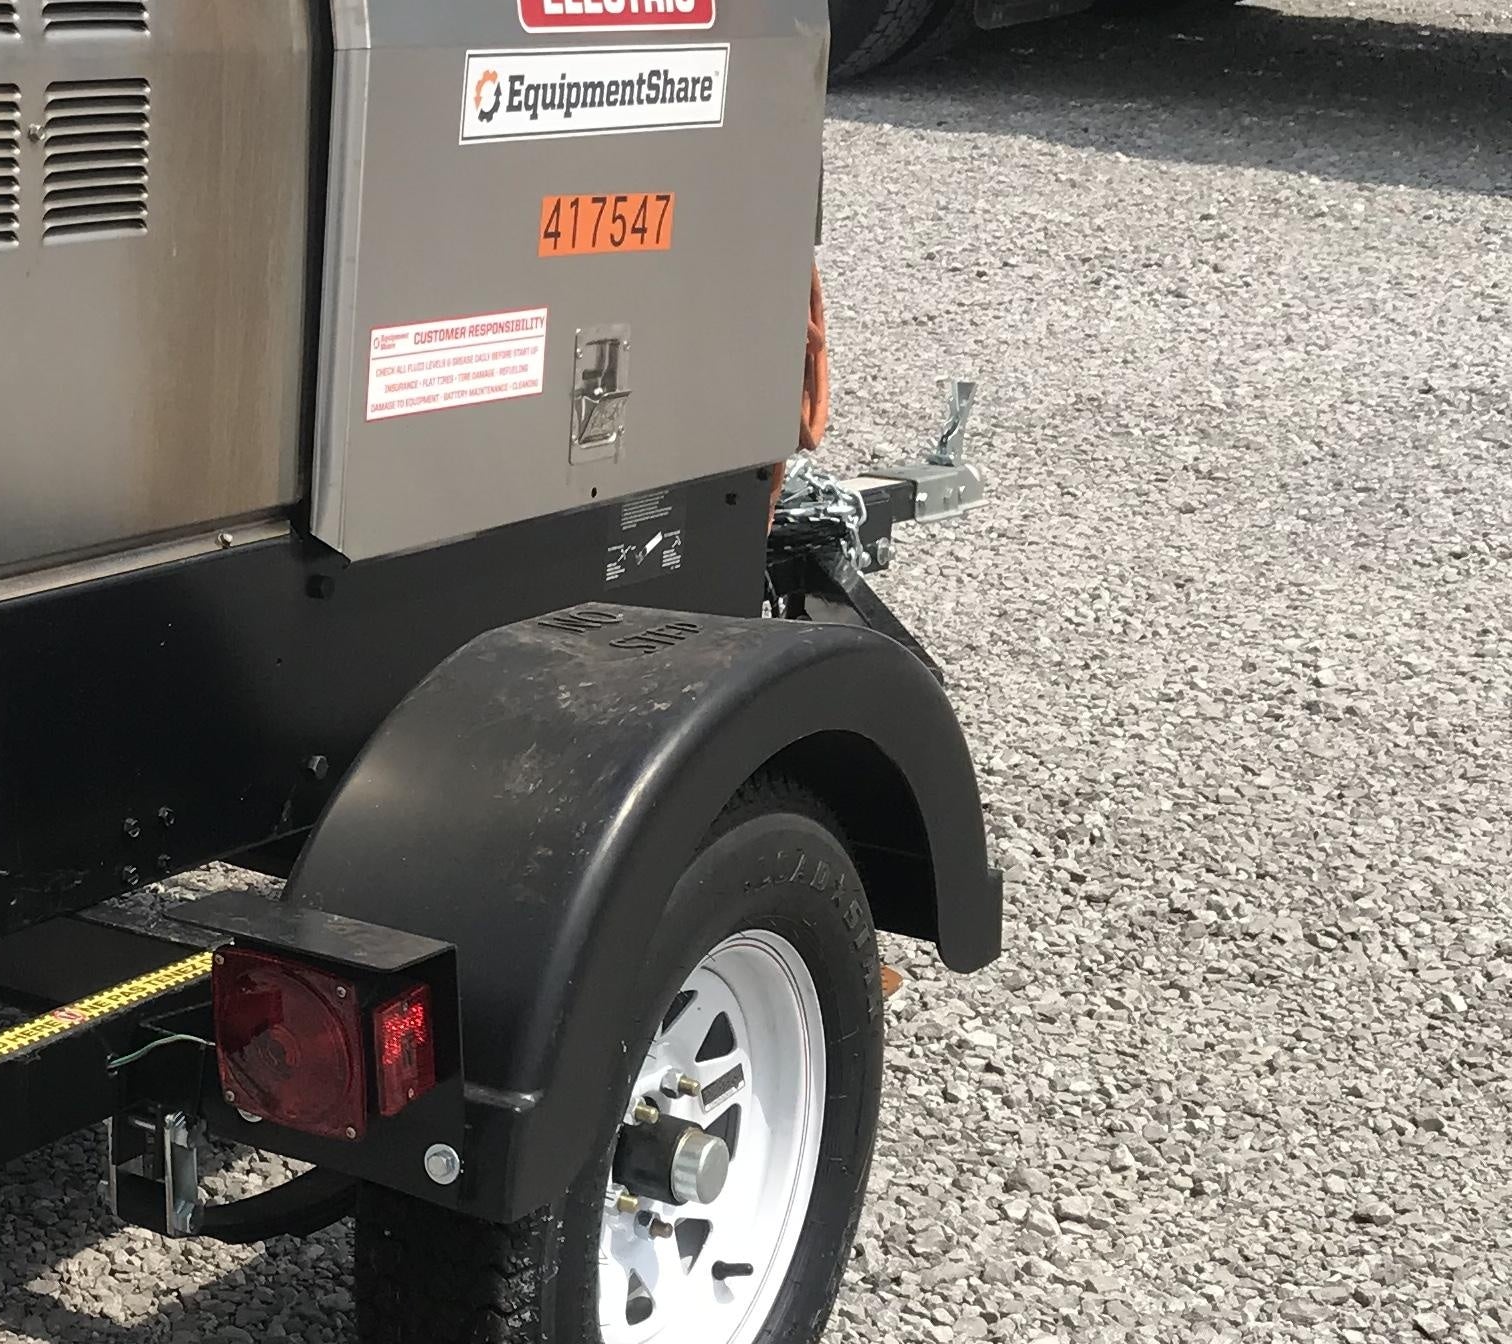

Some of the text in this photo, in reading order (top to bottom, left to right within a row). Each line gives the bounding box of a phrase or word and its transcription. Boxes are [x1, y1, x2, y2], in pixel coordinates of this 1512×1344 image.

[505, 69, 714, 120] EquipmentShare
[542, 194, 672, 251] 417547
[413, 315, 545, 345] CUSTOMER RESPONSIBILITY
[538, 611, 623, 634] NO
[79, 964, 204, 1014] NE PAS TENEZ
[9, 1019, 60, 1042] HERE
